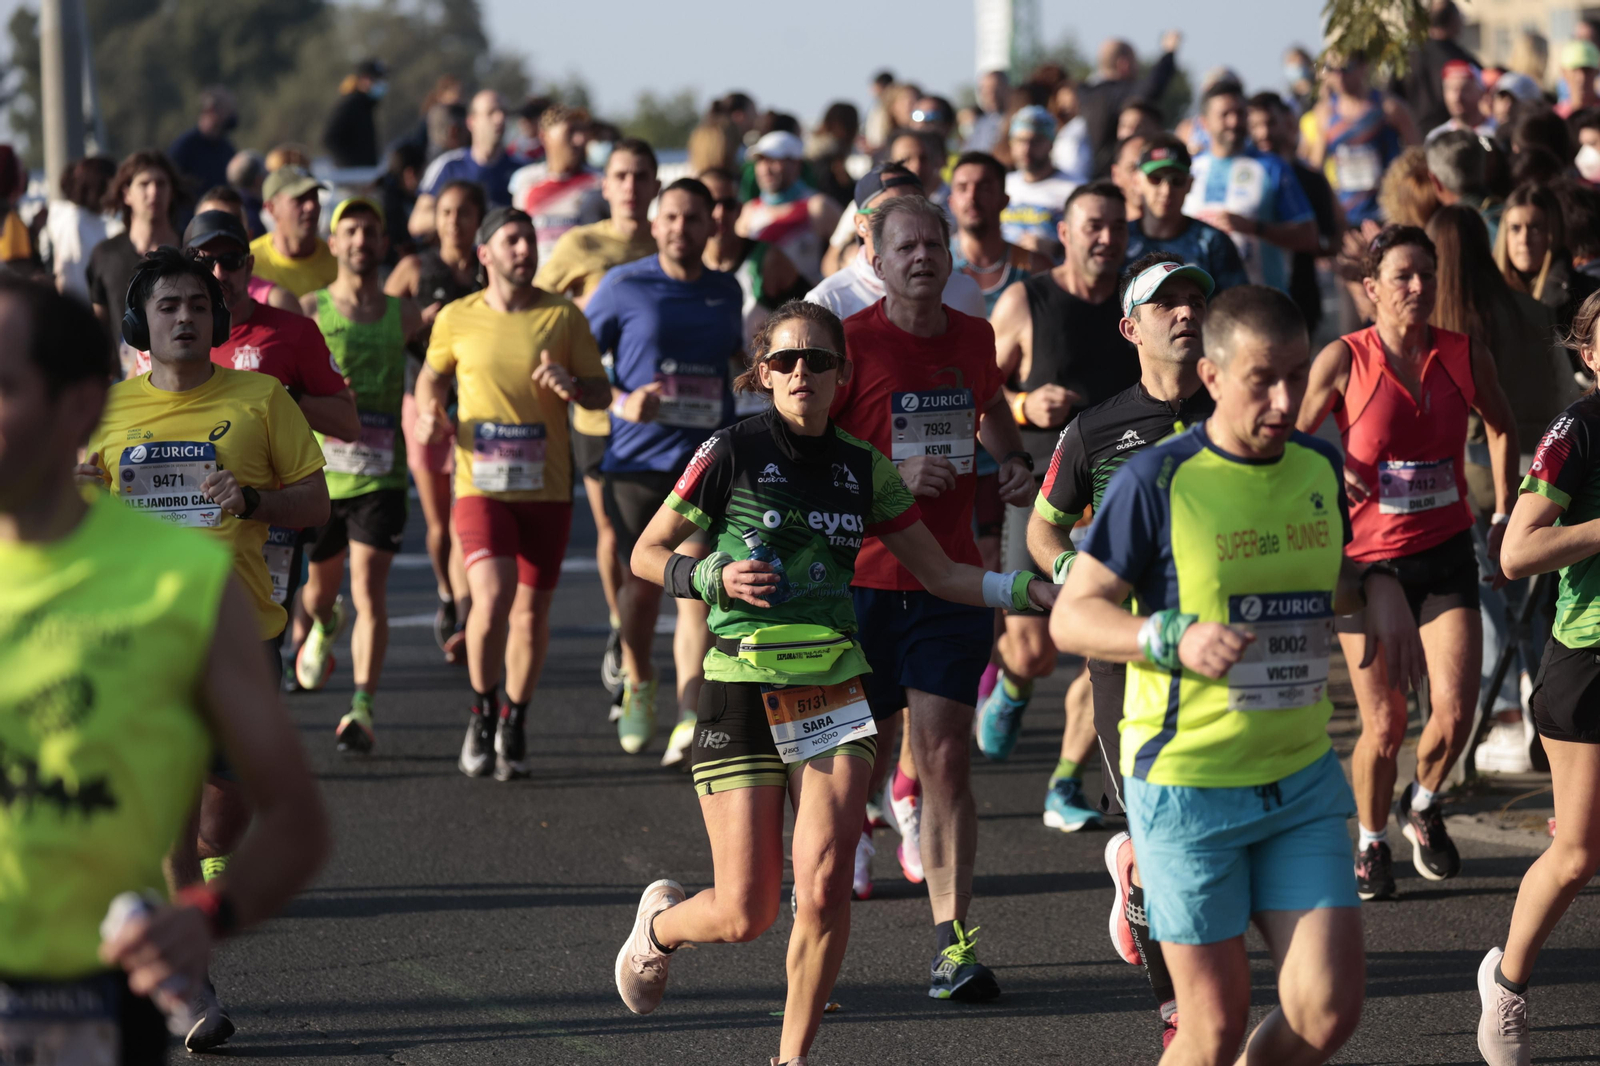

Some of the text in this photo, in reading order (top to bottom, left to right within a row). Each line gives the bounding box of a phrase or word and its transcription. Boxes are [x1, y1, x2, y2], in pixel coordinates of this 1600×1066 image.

[922, 394, 968, 408] ZURICH
[924, 422, 951, 436] 7932
[1558, 417, 1575, 440] TRAIL
[151, 445, 205, 459] ZURICH
[925, 444, 951, 455] KEVIN
[153, 473, 185, 488] 9471
[1408, 478, 1436, 491] 7412
[125, 495, 188, 509] ALEJANDRO
[1410, 496, 1436, 509] DILOU
[828, 535, 862, 548] TRAIL
[1285, 519, 1332, 551] RUNNER
[1269, 636, 1307, 654] 8002
[1267, 665, 1309, 680] VICTOR
[798, 693, 828, 713] 5131
[803, 715, 834, 734] SARA
